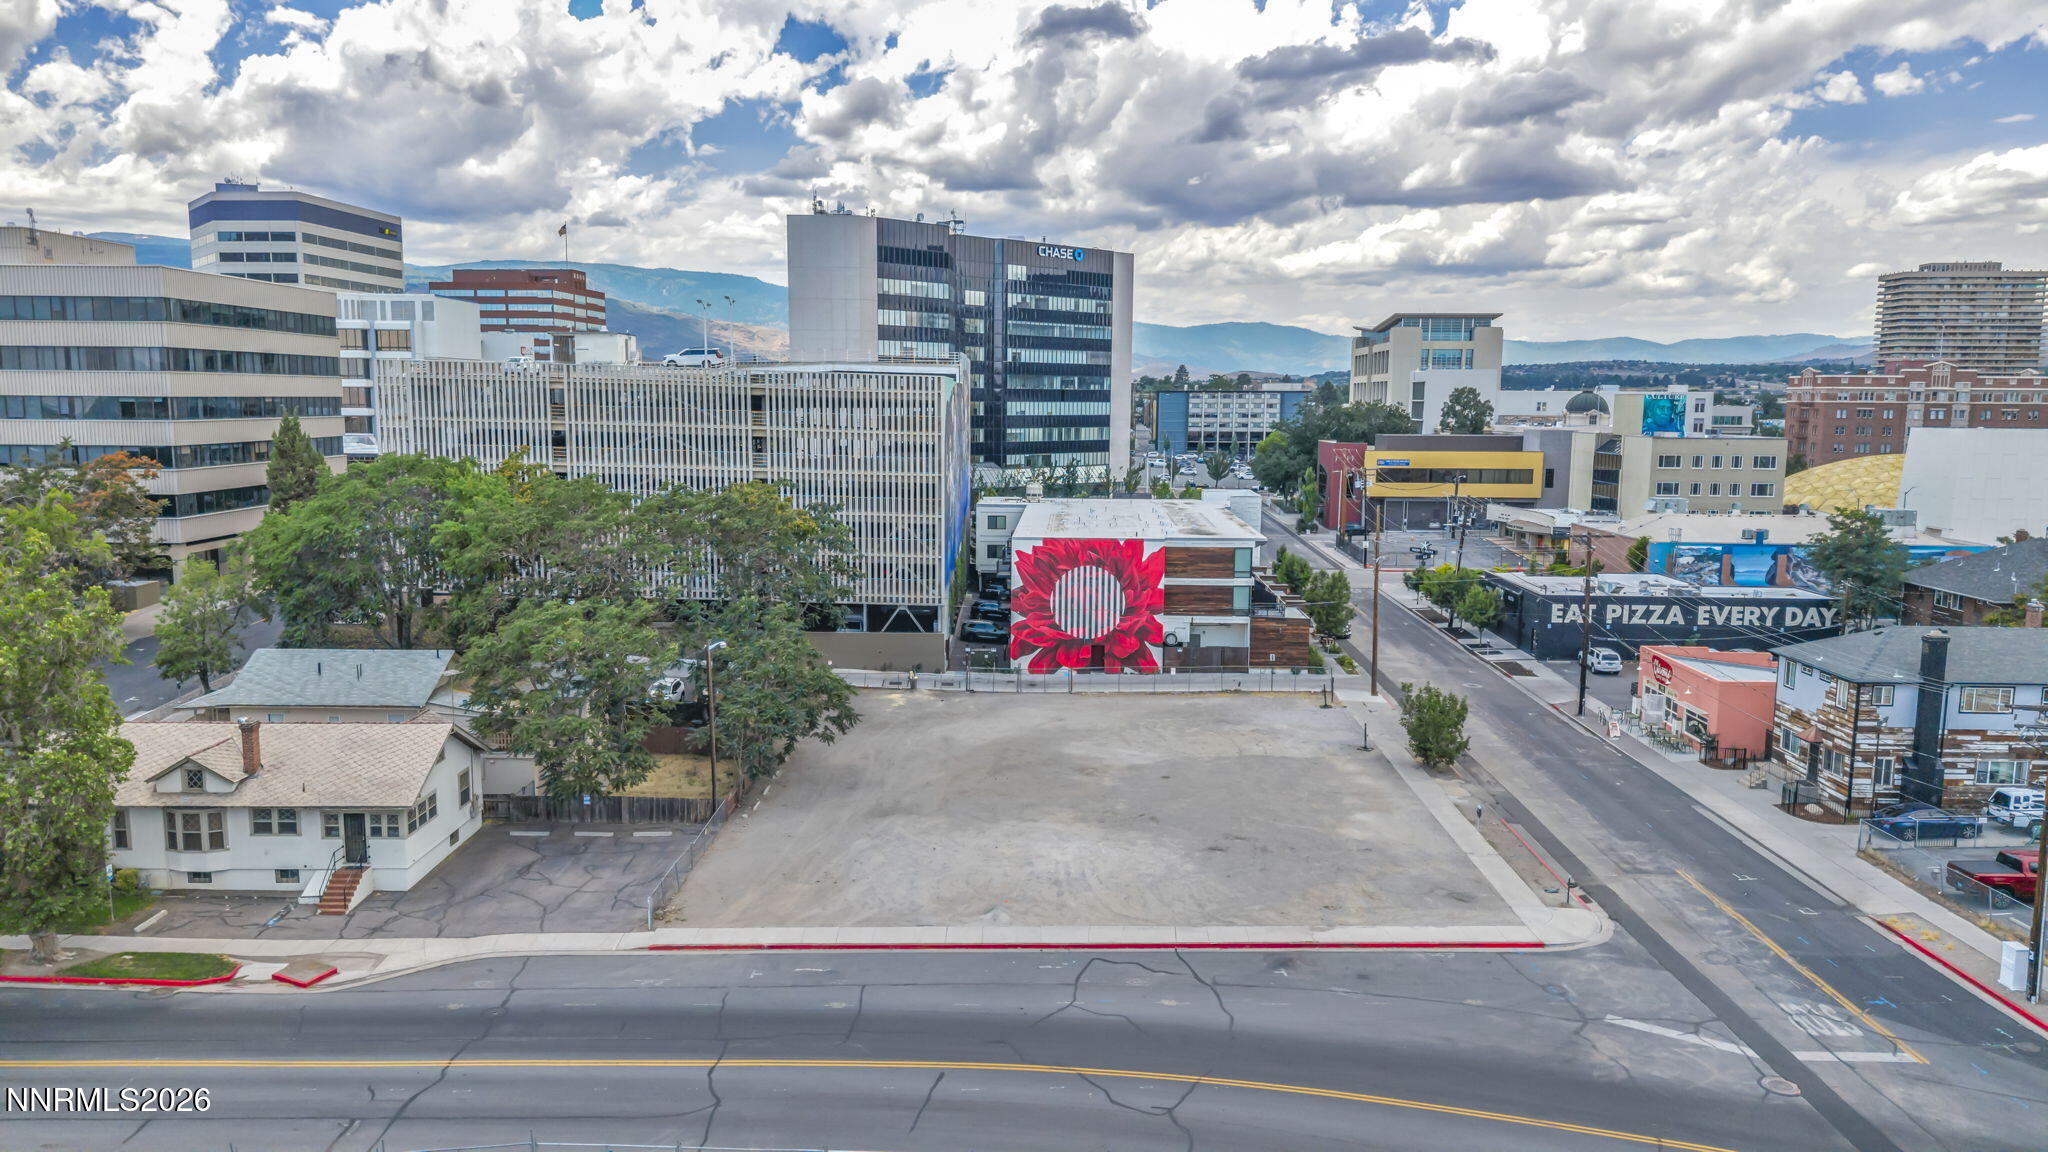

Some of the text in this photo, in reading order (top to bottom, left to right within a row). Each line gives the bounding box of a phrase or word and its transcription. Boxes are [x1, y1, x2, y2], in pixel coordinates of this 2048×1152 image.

[1038, 245, 1074, 260] CHASE
[1551, 603, 1838, 628] EAT PIZZA EVERY DAY
